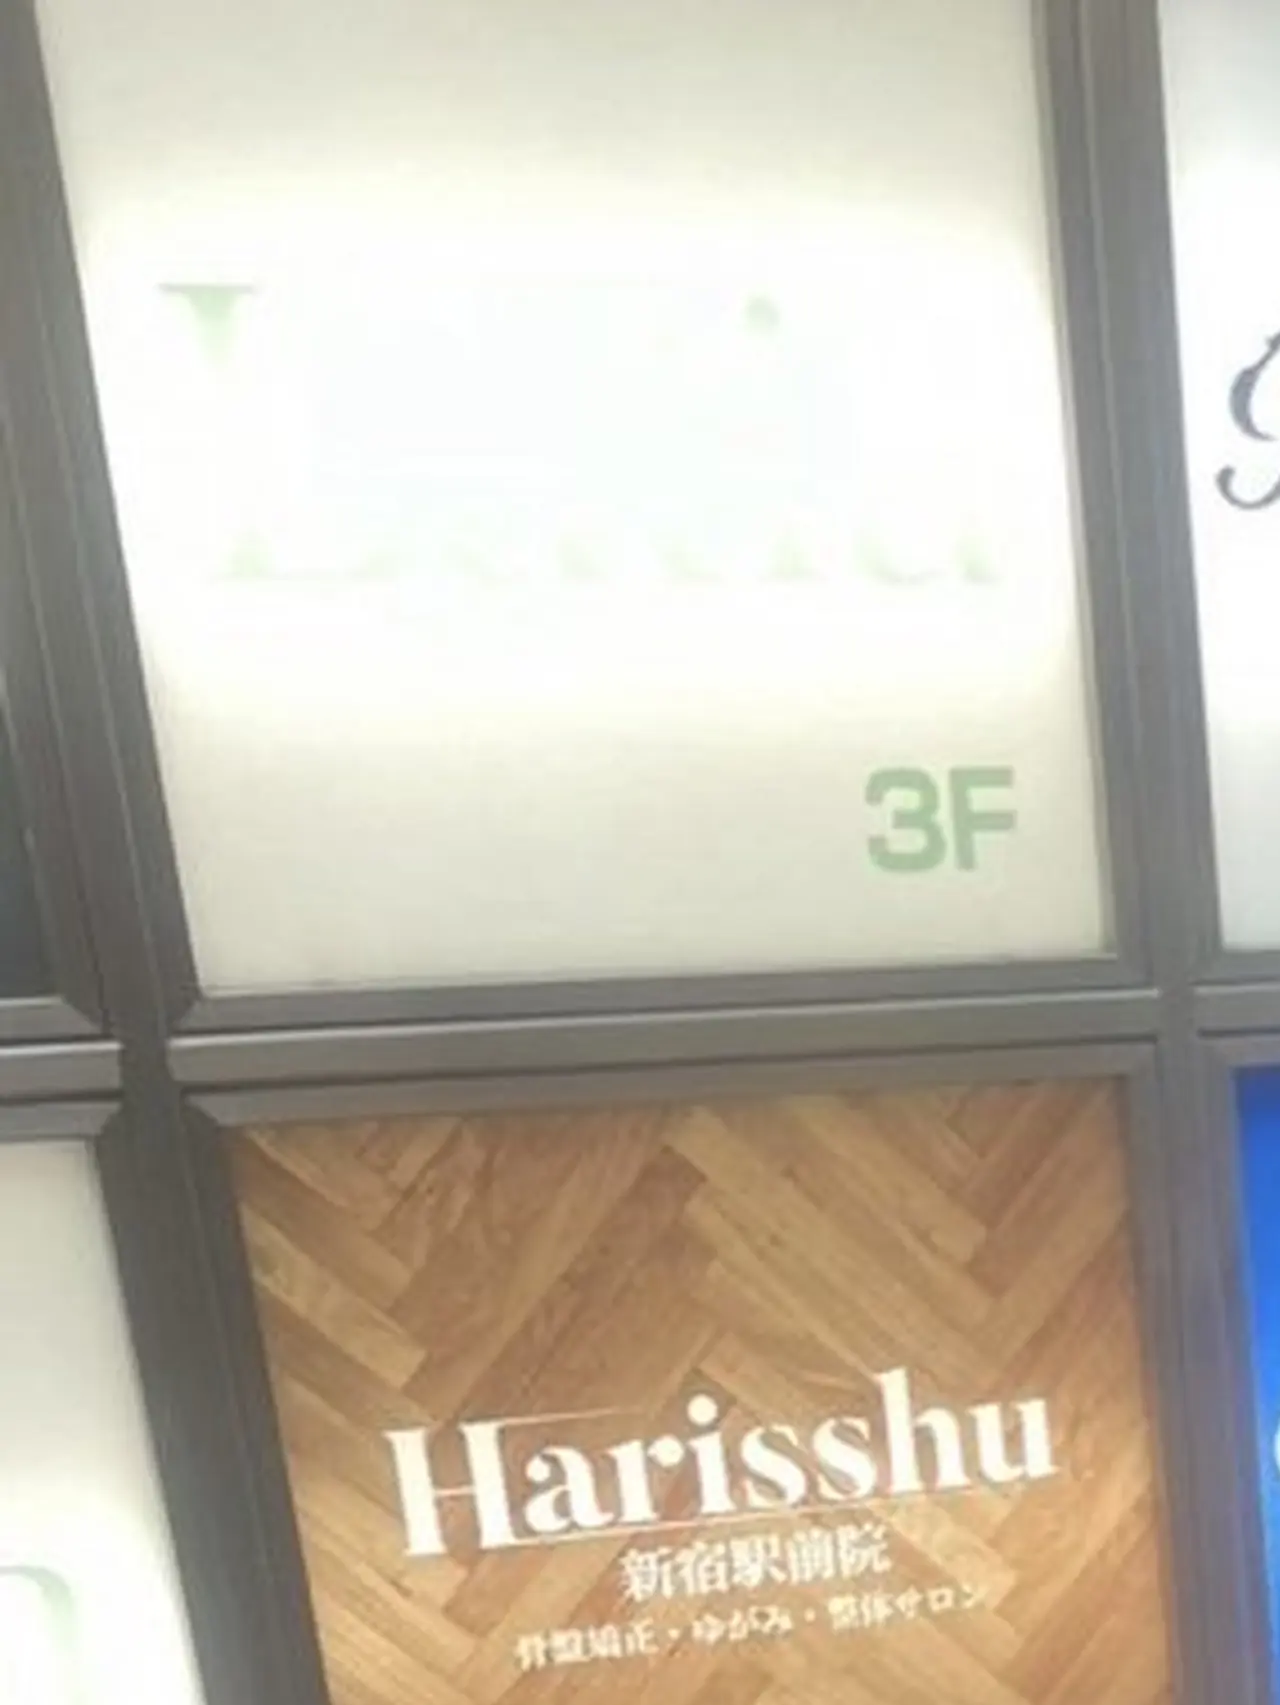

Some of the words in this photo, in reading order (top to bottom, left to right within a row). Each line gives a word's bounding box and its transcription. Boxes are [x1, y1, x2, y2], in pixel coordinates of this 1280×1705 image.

[864, 765, 1017, 873] 3F
[384, 1364, 1060, 1560] Harisshu
[618, 1522, 894, 1602] 新宿駅前院
